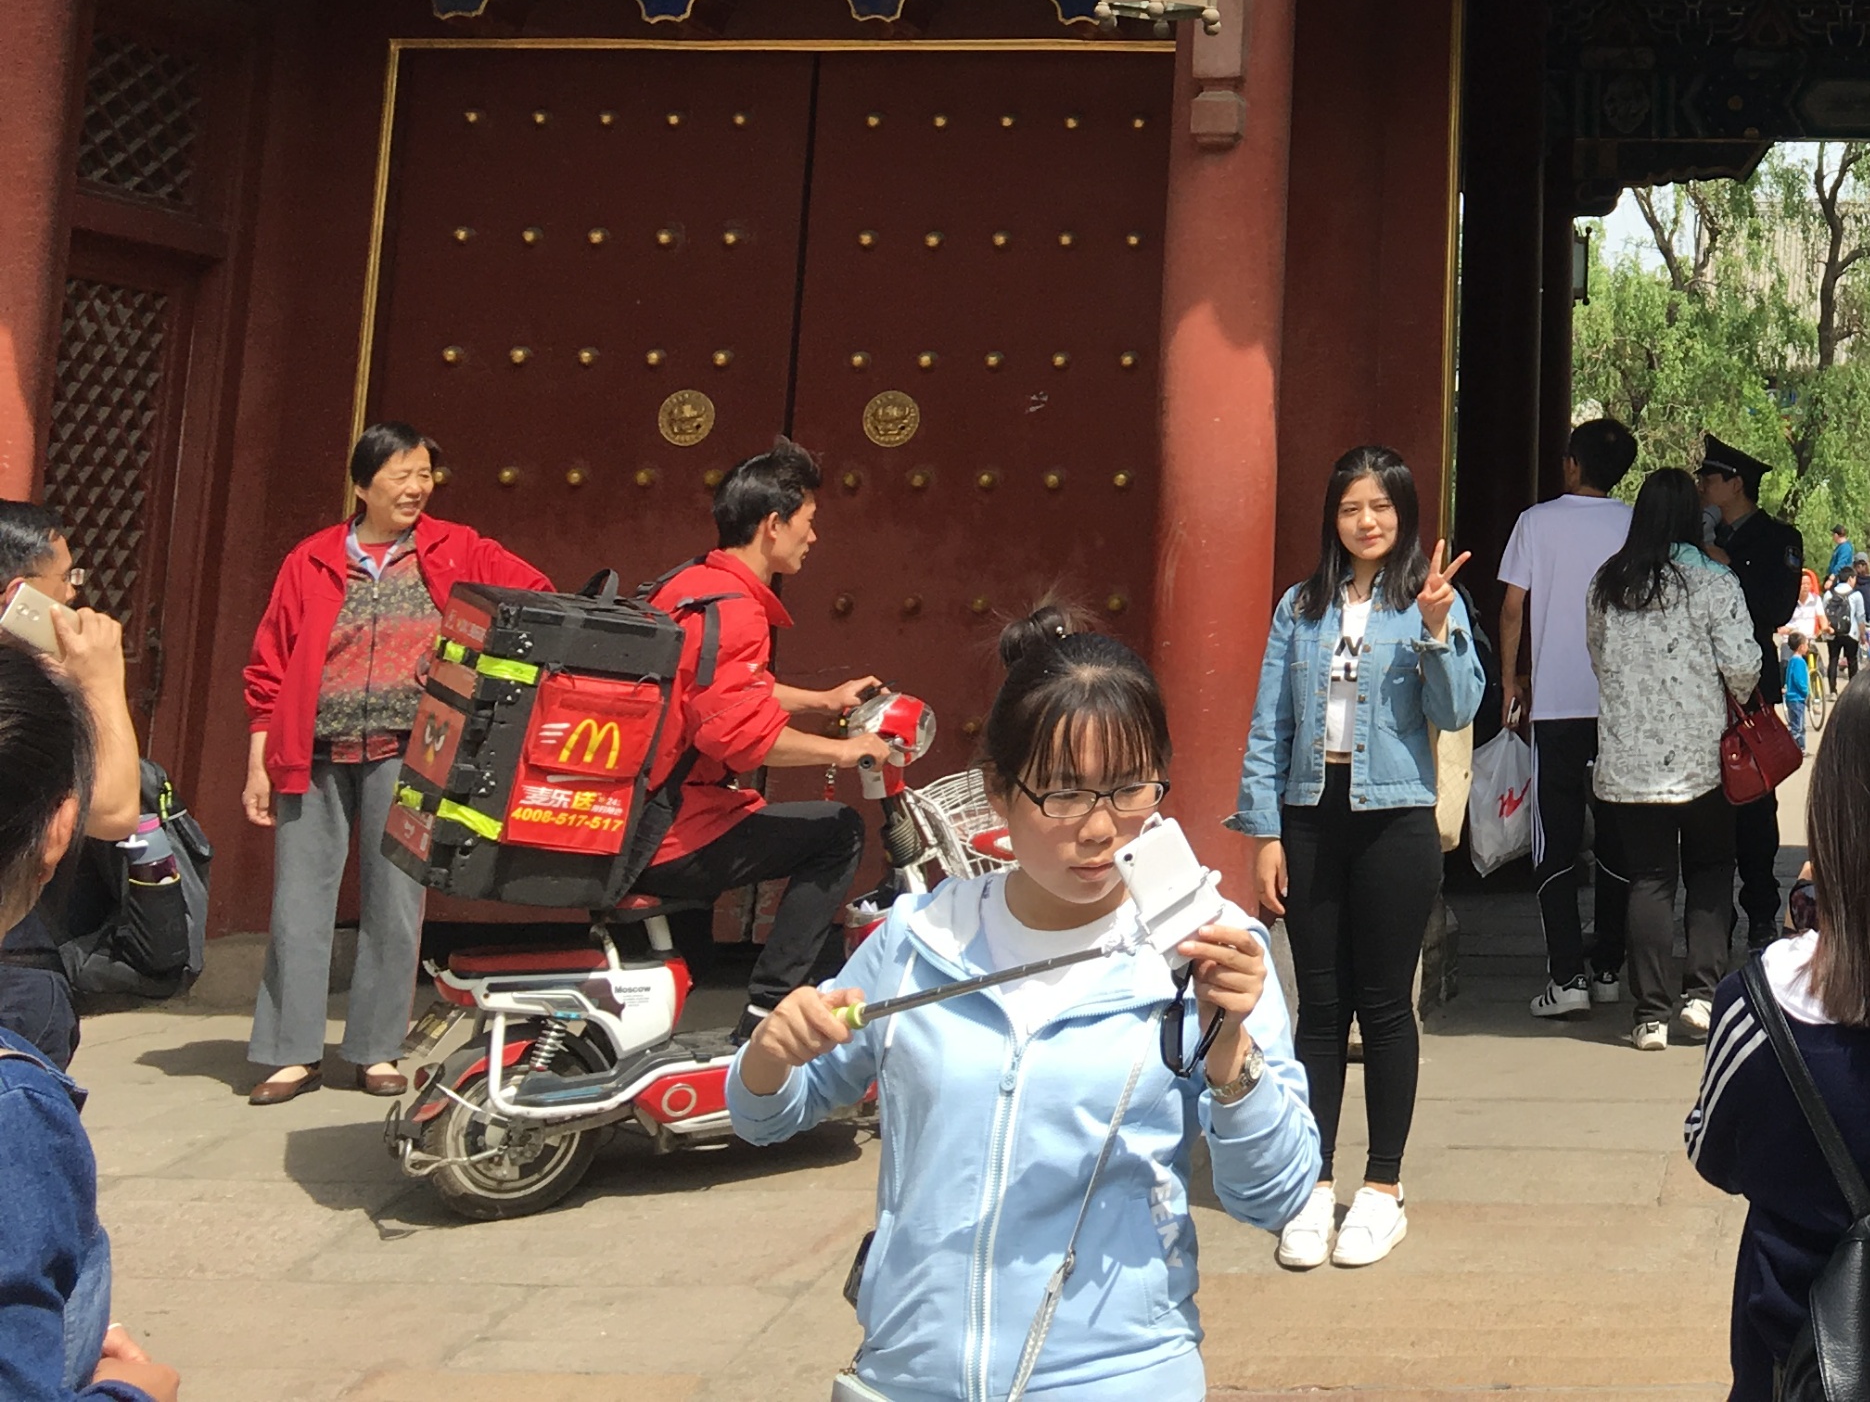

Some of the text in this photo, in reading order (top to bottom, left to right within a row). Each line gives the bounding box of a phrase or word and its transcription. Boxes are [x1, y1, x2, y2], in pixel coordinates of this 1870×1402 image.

[519, 785, 597, 810] 麦乐送
[511, 807, 624, 831] 4008-517-517
